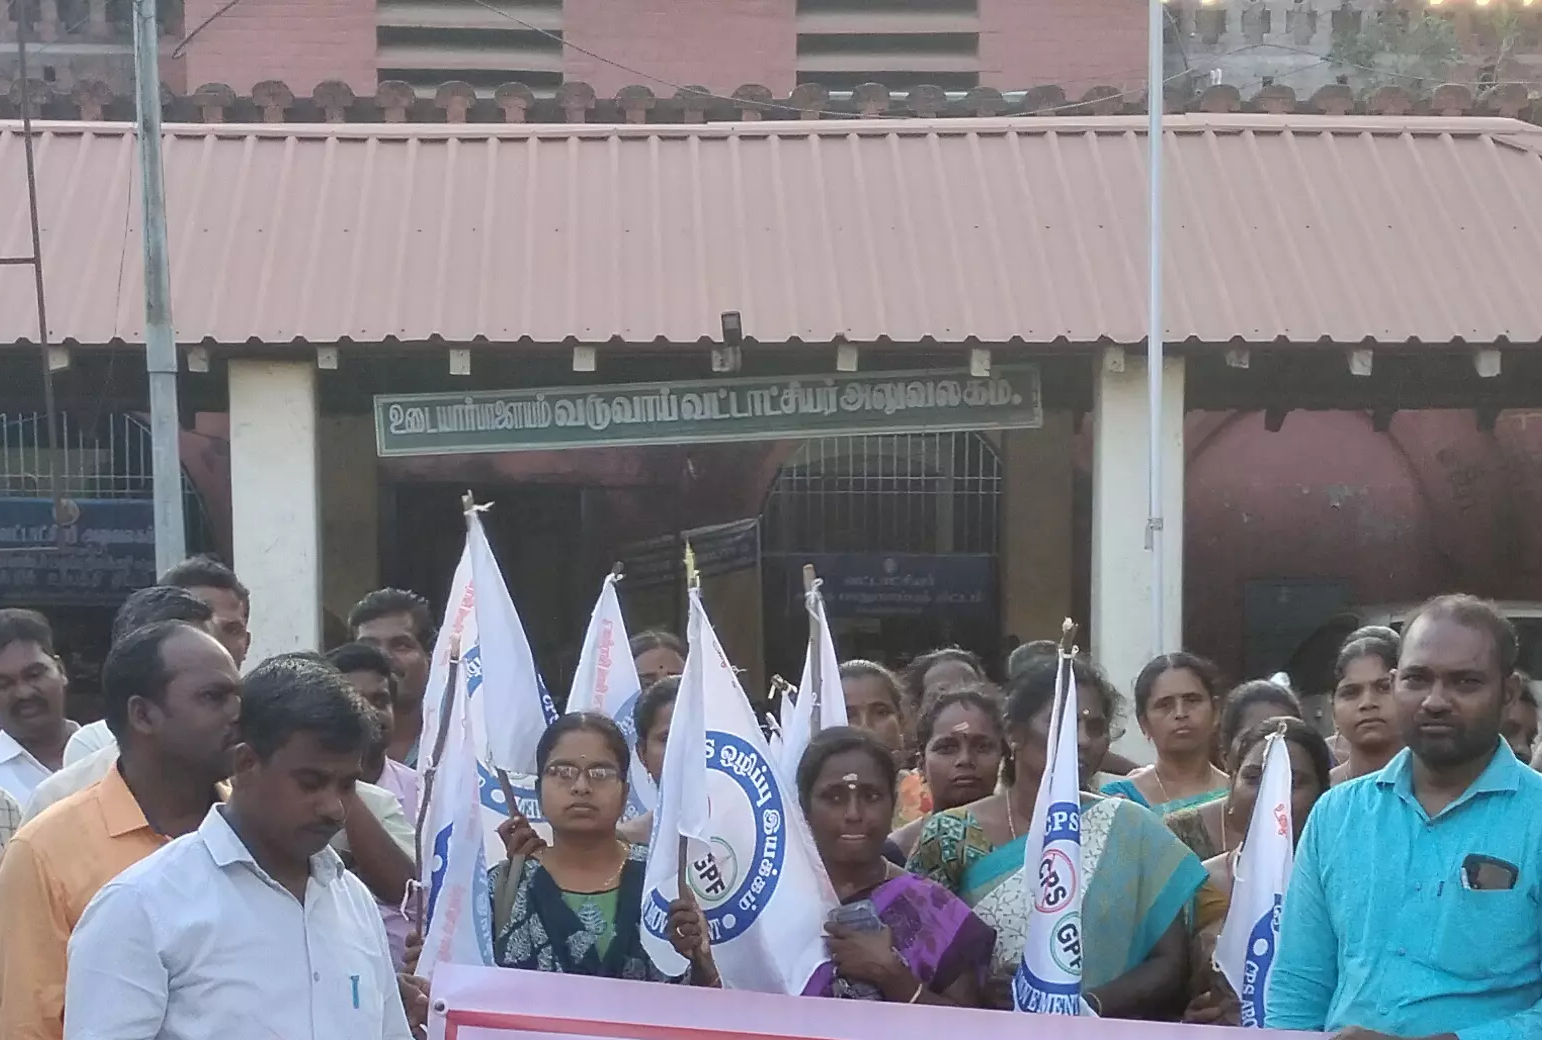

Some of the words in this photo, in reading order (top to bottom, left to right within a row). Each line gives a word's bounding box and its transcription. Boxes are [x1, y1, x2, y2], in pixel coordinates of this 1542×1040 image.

[389, 394, 552, 435] உடையார்பாளையம்
[555, 387, 679, 430] வருவாய்
[680, 379, 839, 421] வட்டாட்சியர்
[720, 745, 772, 808] ஒழிப்பு
[739, 809, 781, 912] இயக்கம்
[1038, 858, 1068, 907] CPS
